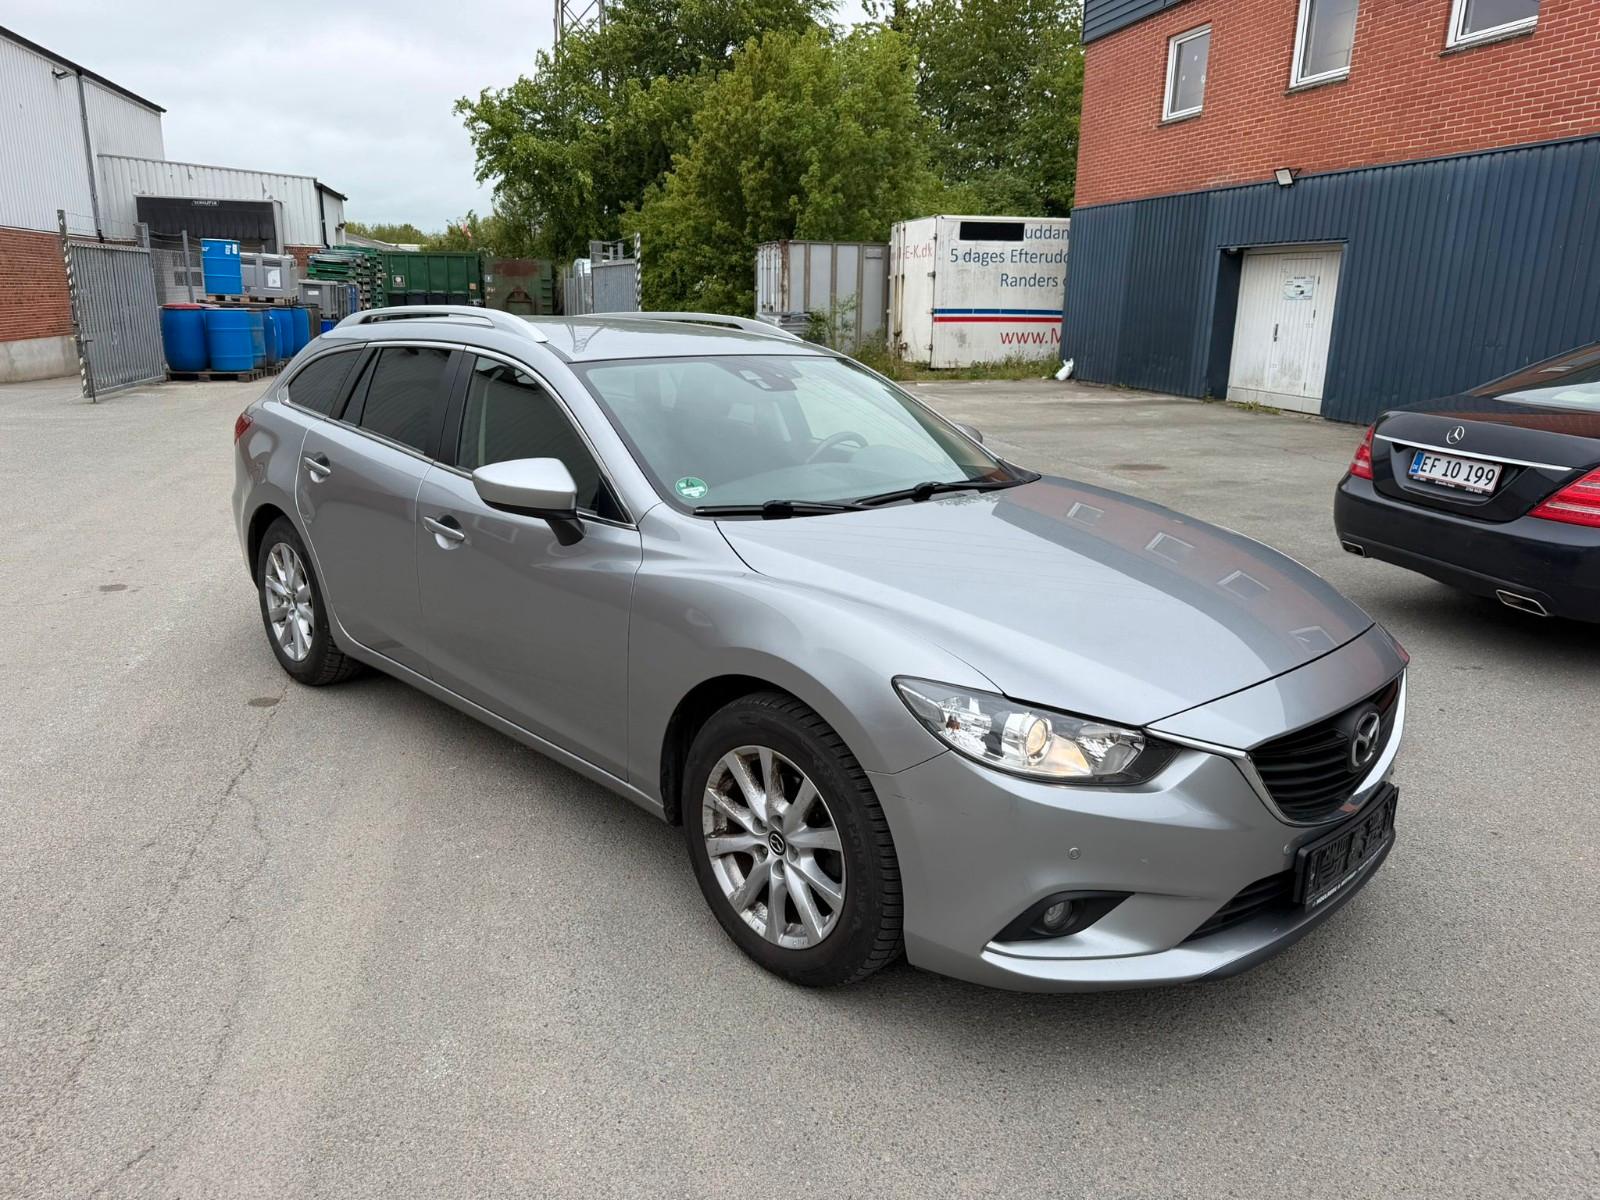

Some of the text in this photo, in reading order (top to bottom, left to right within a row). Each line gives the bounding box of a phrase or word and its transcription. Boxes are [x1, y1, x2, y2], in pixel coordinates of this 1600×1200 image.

[950, 248, 959, 263] 5
[963, 248, 1005, 266] dages
[1000, 273, 1058, 288] Randers
[1420, 456, 1441, 473] EF
[1442, 460, 1462, 479] 10
[1463, 464, 1496, 486] 199
